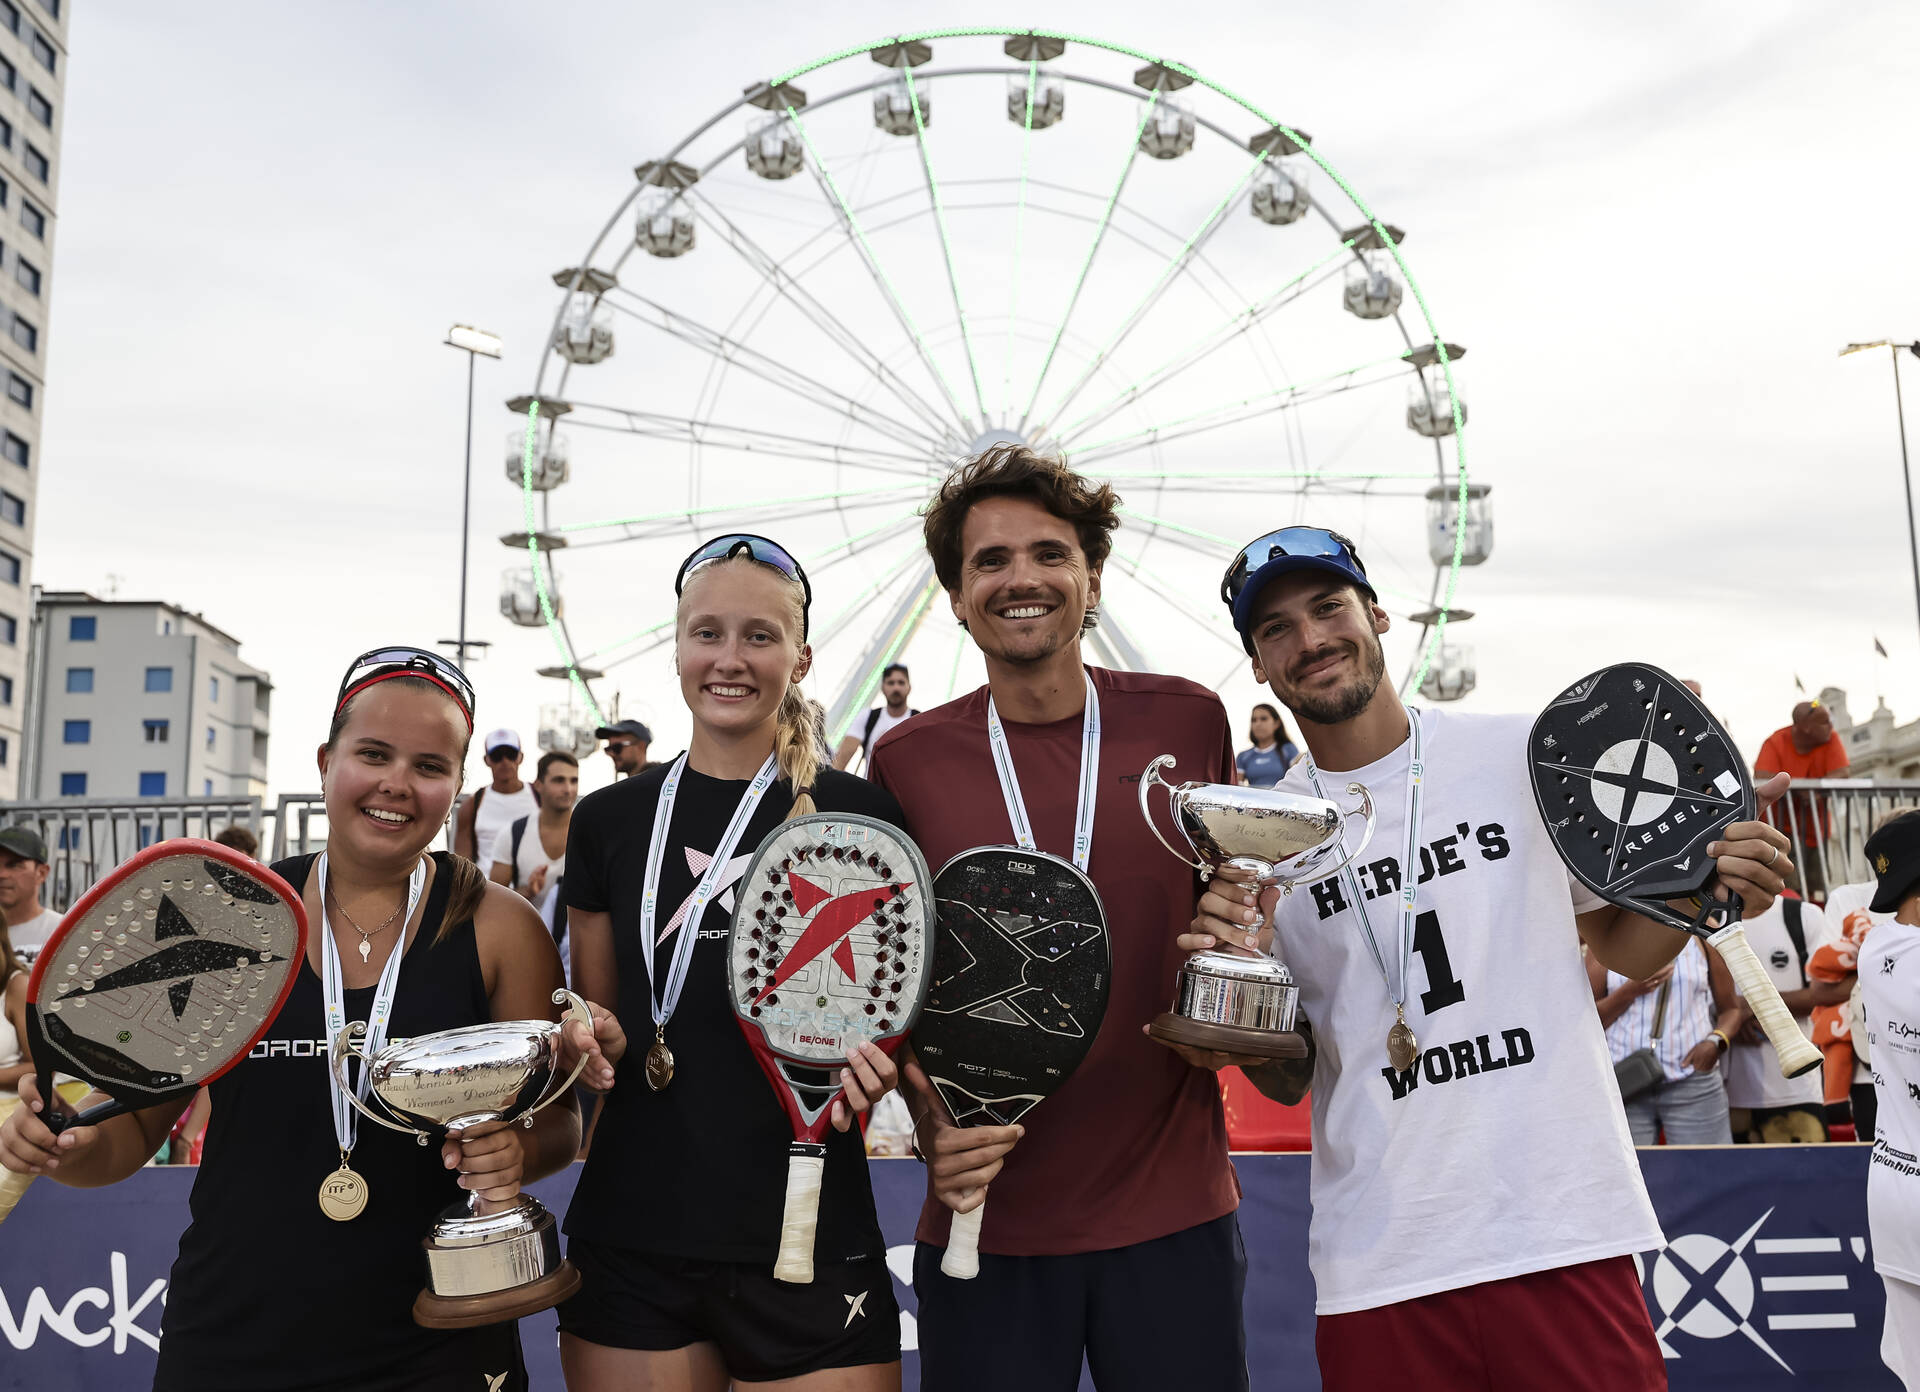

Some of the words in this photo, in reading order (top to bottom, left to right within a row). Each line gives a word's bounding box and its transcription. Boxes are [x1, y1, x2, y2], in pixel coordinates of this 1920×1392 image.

[1412, 764, 1420, 776] ITF
[666, 783, 676, 796] ITF
[754, 778, 765, 790] ITF
[1625, 805, 1700, 854] REBEL
[1077, 836, 1085, 851] ITF
[698, 883, 710, 897] ITF
[1403, 886, 1412, 903] ITF
[646, 898, 654, 913] ITF
[1412, 909, 1466, 1016] 1
[376, 1000, 386, 1016] ITF
[332, 1013, 341, 1029] ITF
[799, 1035, 836, 1047] BE/ONE
[1381, 1027, 1535, 1100] WORLD
[405, 1096, 455, 1109] Women's
[329, 1184, 346, 1194] ITF
